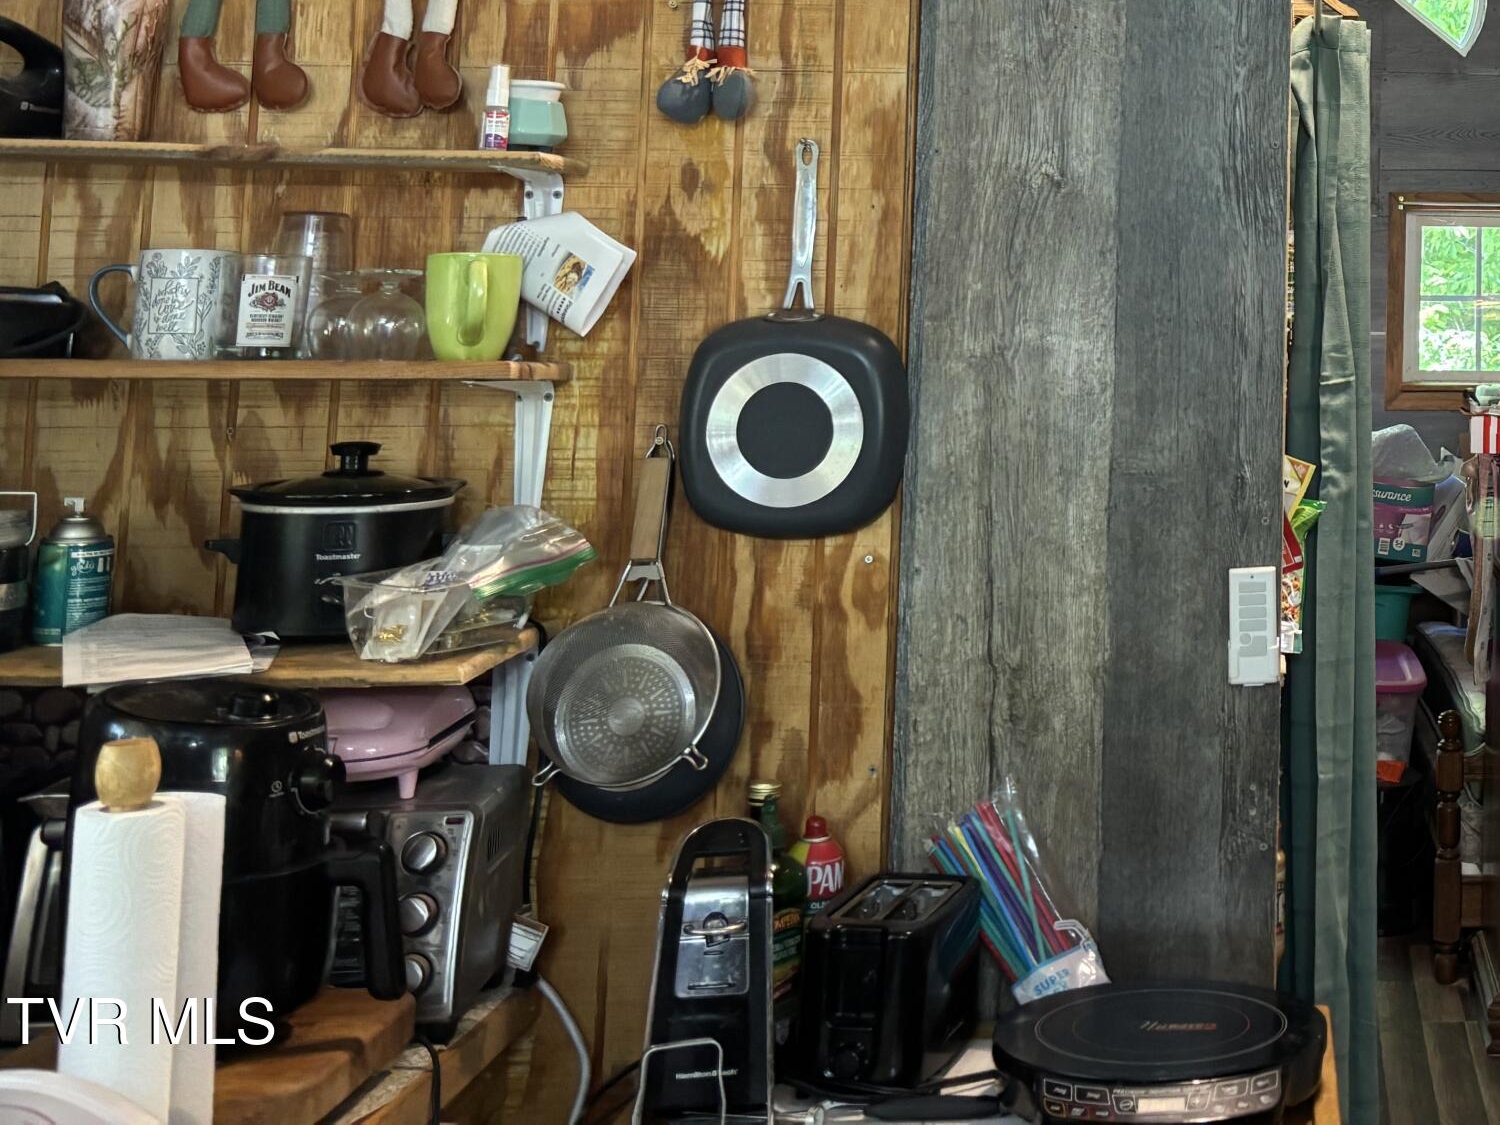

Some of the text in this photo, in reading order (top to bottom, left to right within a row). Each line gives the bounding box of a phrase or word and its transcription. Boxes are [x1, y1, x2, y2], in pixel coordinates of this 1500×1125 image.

[247, 280, 291, 298] JIM BEAM
[315, 553, 361, 561] Toastmaster
